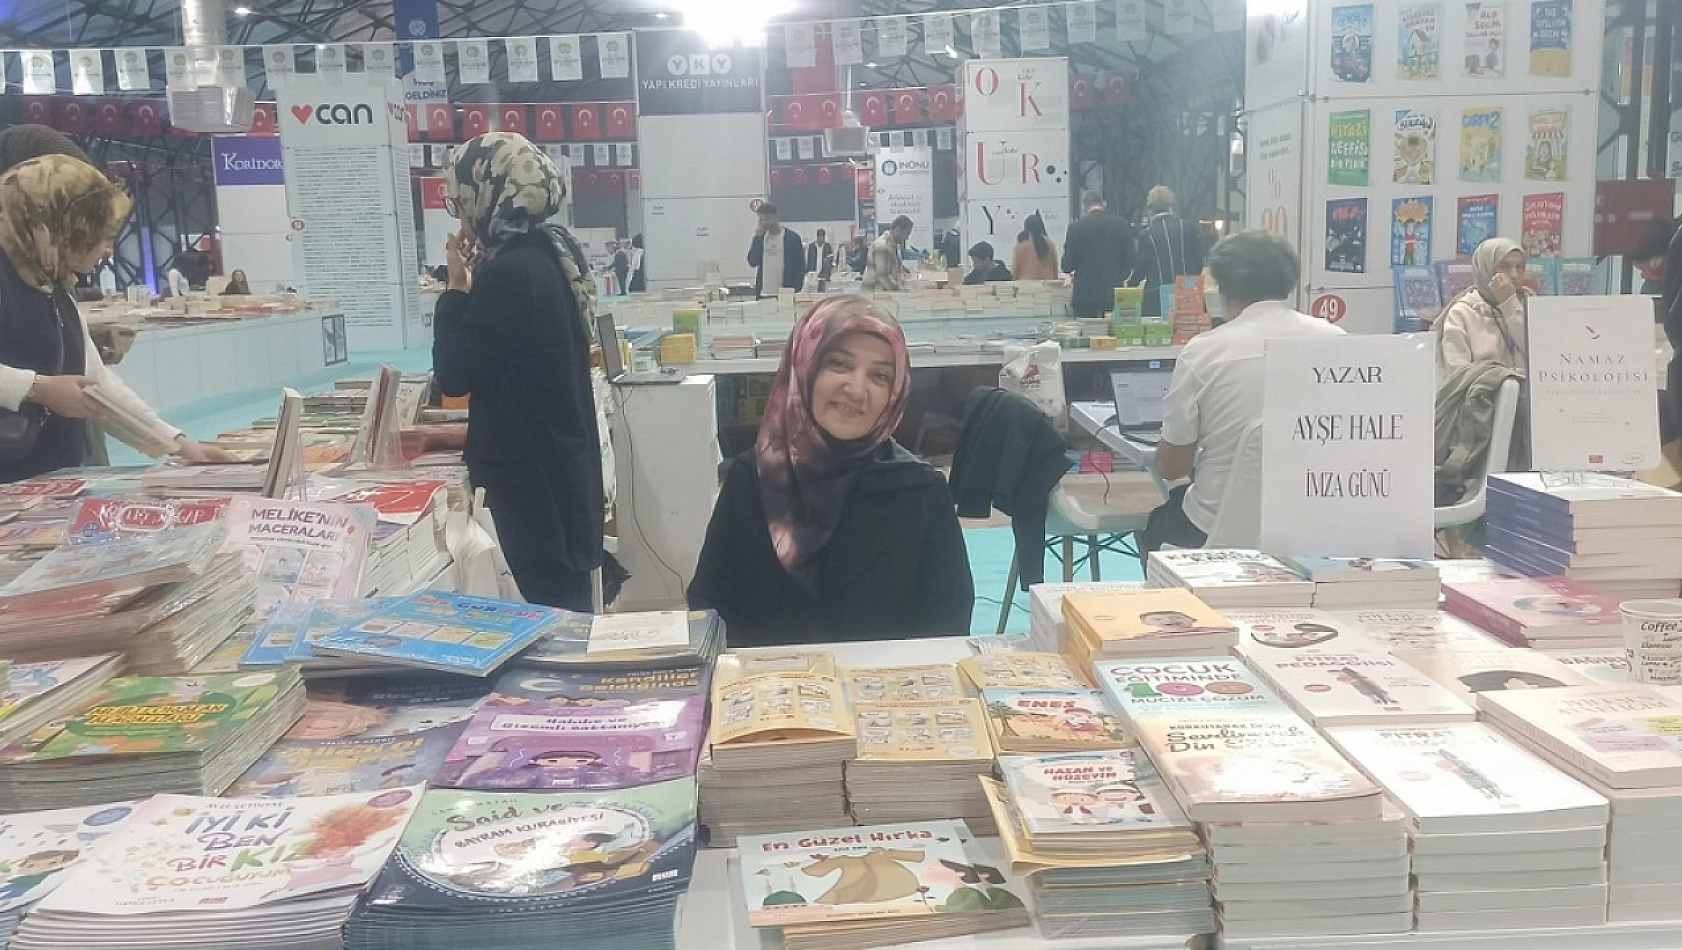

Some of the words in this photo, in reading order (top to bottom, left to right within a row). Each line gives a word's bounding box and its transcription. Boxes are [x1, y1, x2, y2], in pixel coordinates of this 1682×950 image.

[315, 103, 374, 125] can
[1320, 298, 1339, 320] 49
[1560, 353, 1626, 365] NAMAZ
[1312, 366, 1383, 384] YAZAR
[1539, 369, 1649, 384] PSİKOLOJİSİ
[1292, 413, 1343, 446] AYŞE
[1350, 413, 1404, 440] HALE
[1306, 467, 1344, 497] İMZA
[1347, 467, 1392, 498] GÜNÜ
[251, 507, 348, 529] MELİKE'NİN
[248, 523, 341, 542] MACERALARI
[1641, 620, 1678, 633] Coffee
[1017, 700, 1076, 708] ENES
[445, 805, 523, 832] Said
[197, 827, 293, 851] BEN
[454, 827, 513, 848] BAYRAM
[762, 841, 790, 853] En
[796, 832, 863, 849] Güzel
[868, 829, 934, 842] Hırka
